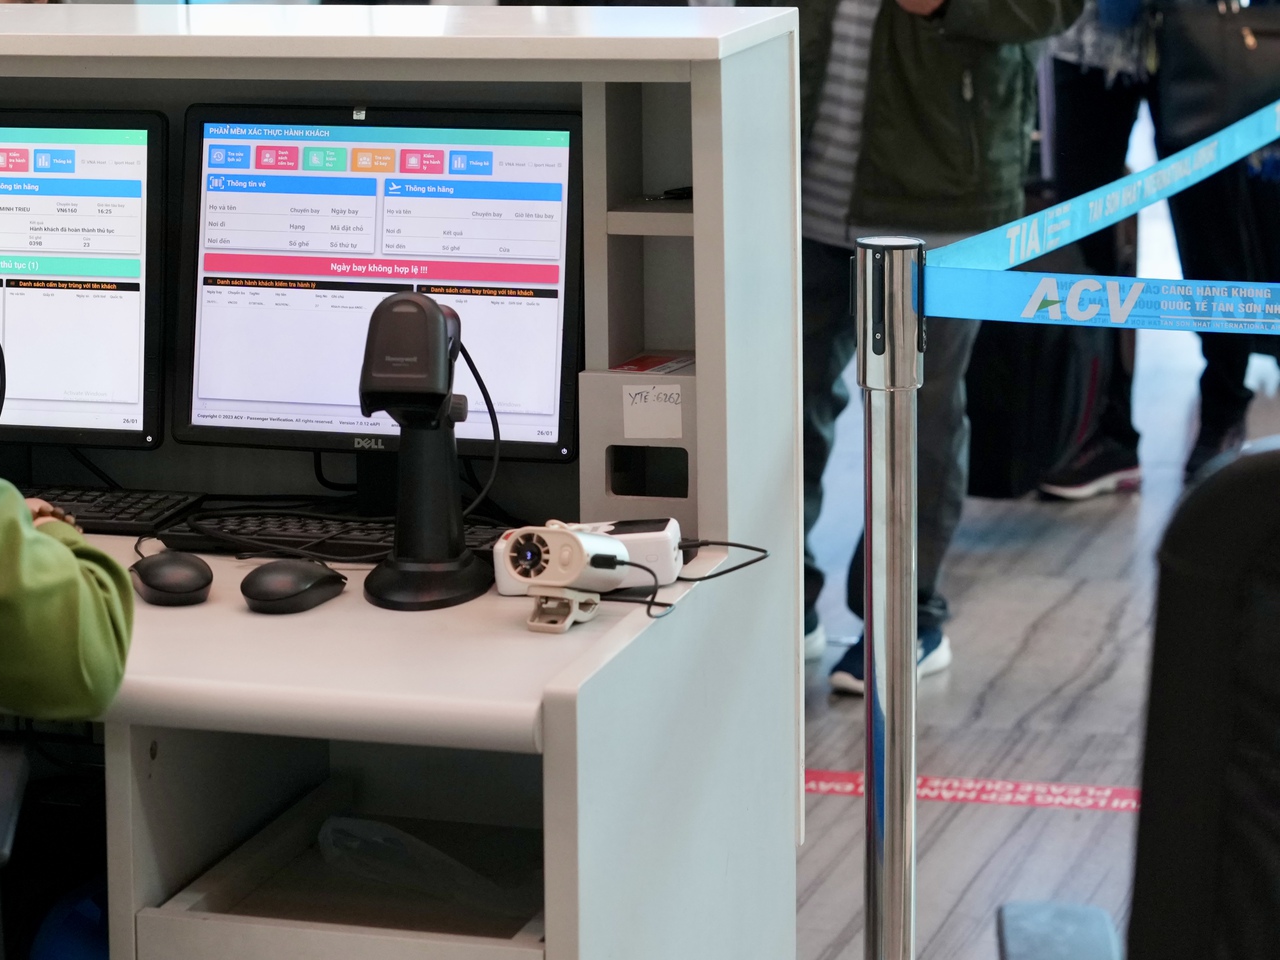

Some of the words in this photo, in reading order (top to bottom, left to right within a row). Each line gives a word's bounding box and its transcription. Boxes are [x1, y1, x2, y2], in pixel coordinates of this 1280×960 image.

[230, 127, 246, 135] MỀM
[264, 128, 282, 137] THỰC
[284, 128, 303, 136] HÀNH
[305, 128, 330, 136] KHÁCH
[227, 180, 246, 188] Thông
[405, 185, 425, 193] Thông
[1006, 218, 1040, 264] TIA
[1, 260, 13, 268] thủ
[15, 262, 26, 270] tục
[28, 261, 38, 270] (1)
[331, 263, 351, 272] Ngày
[353, 264, 366, 273] bay
[368, 264, 392, 274] không
[395, 265, 410, 274] hợp
[411, 266, 418, 274] lệ
[420, 266, 428, 274] !!!
[1162, 285, 1192, 296] CẢNG
[1197, 285, 1228, 297] HÀNG
[1232, 286, 1271, 298] KHÔNG
[1020, 277, 1145, 324] ACV
[1212, 301, 1234, 312] TÂN
[1238, 302, 1261, 313] SƠN
[354, 437, 384, 449] DELL
[935, 777, 1014, 792] QUEUE
[1024, 783, 1111, 797] PLEASE
[916, 788, 975, 800] HÀN
[1112, 798, 1140, 809] UI
